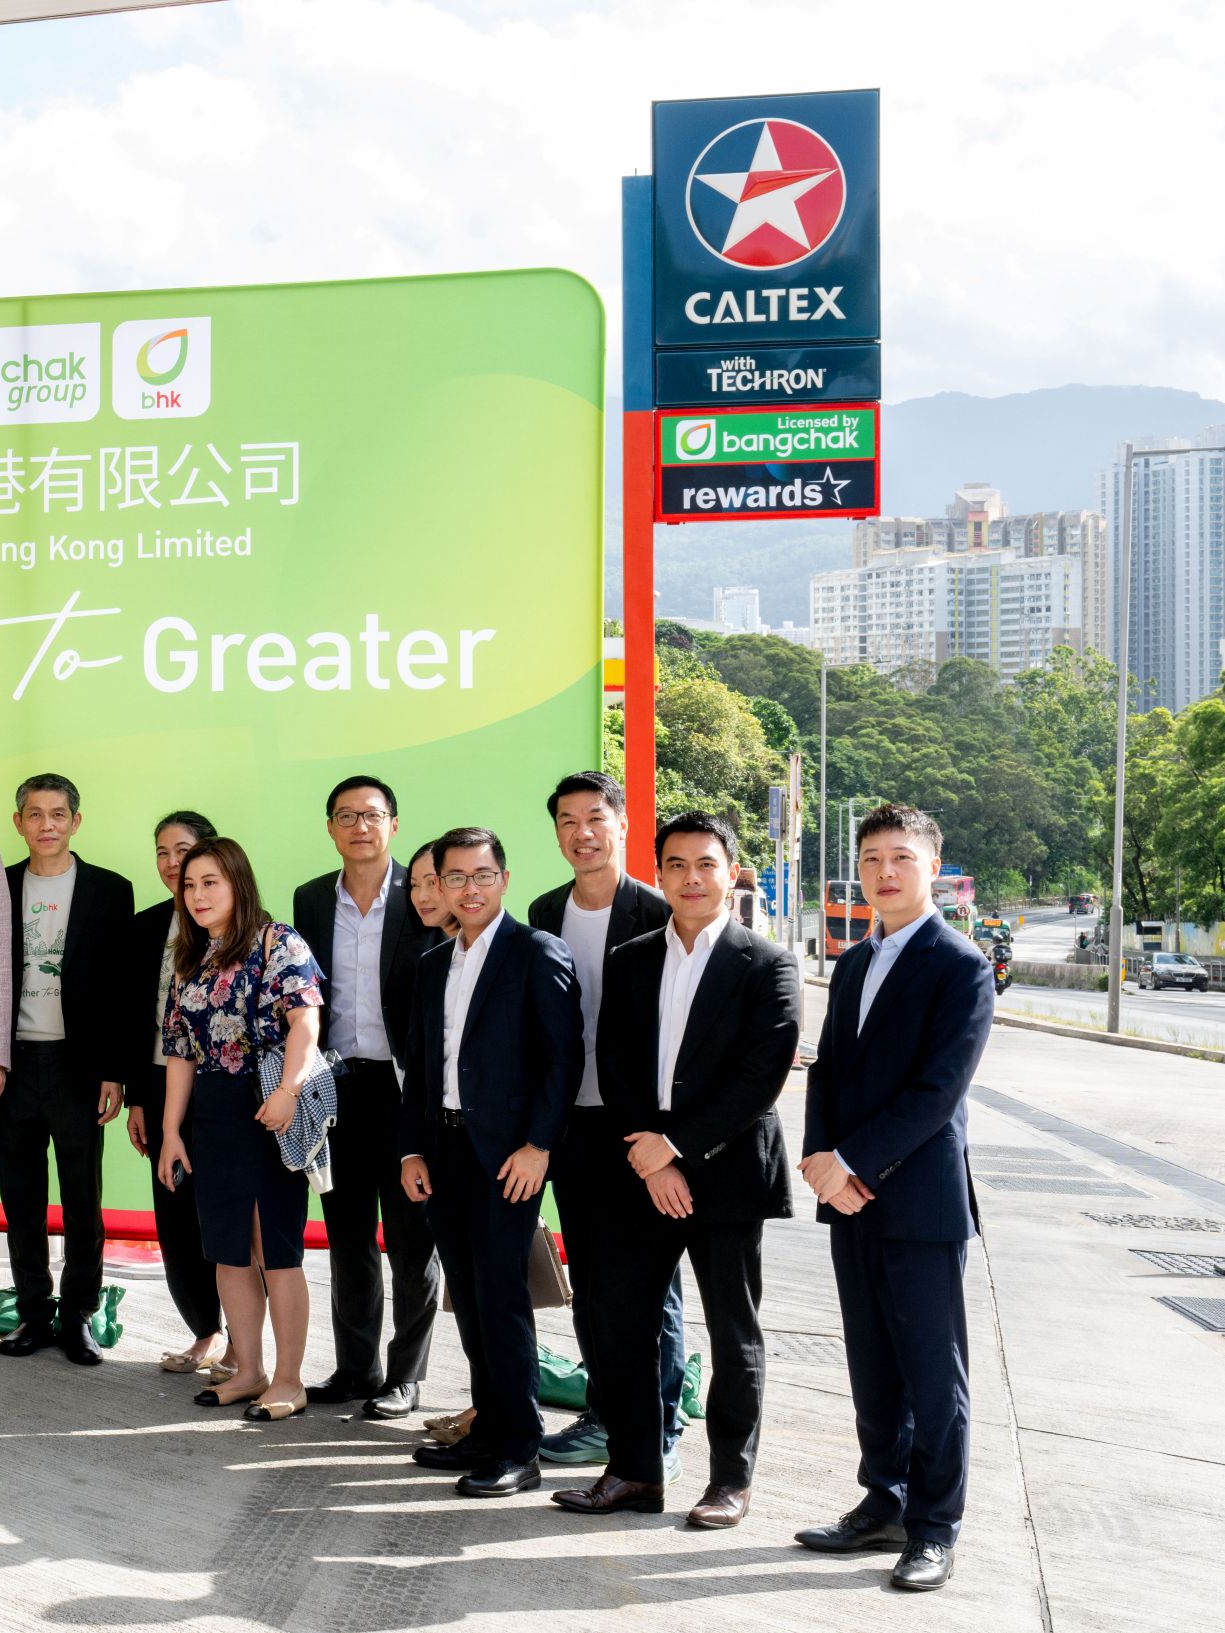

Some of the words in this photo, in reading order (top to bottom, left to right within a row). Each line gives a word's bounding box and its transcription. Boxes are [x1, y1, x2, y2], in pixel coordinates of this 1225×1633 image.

[685, 285, 846, 325] CALTEX
[720, 356, 756, 371] with
[707, 368, 825, 395] TECHRON
[7, 382, 87, 412] group
[141, 390, 182, 409] bhk
[777, 415, 838, 429] Licensed
[842, 414, 859, 430] by
[722, 428, 860, 458] bangchak
[682, 478, 824, 510] rewards
[49, 533, 125, 569] Kong
[137, 527, 253, 559] Limited
[143, 613, 497, 693] Greater
[42, 903, 59, 912] bhk
